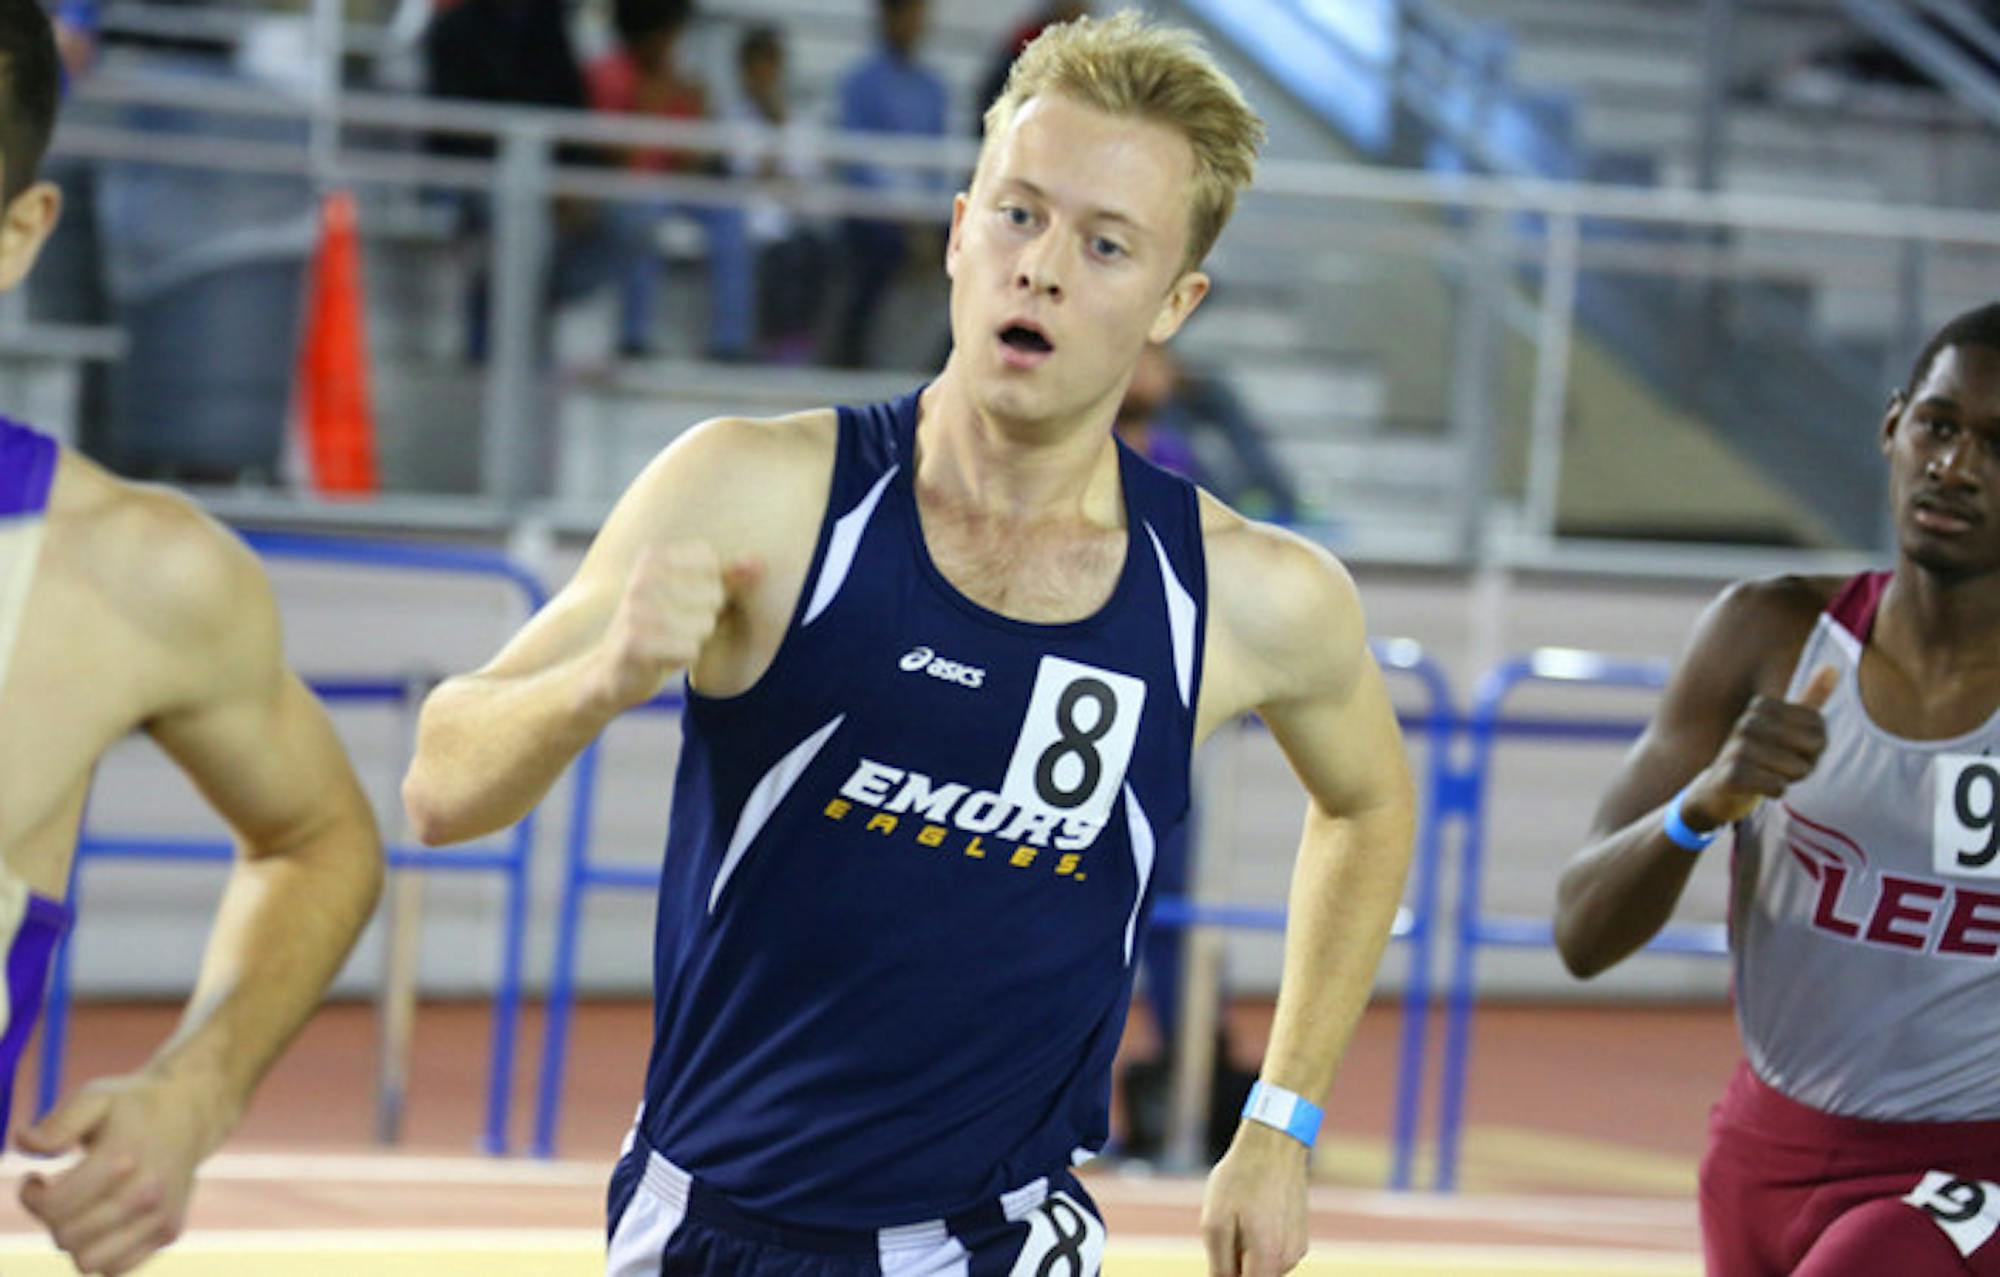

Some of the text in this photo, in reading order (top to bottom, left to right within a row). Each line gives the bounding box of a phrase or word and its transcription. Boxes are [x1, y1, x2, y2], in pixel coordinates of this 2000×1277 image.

[926, 656, 987, 689] asics
[1034, 676, 1118, 809] 8
[1954, 763, 2000, 868] 9
[1813, 864, 2000, 957] LEE
[1035, 1198, 1086, 1277] 8
[1921, 1181, 1986, 1222] 9
